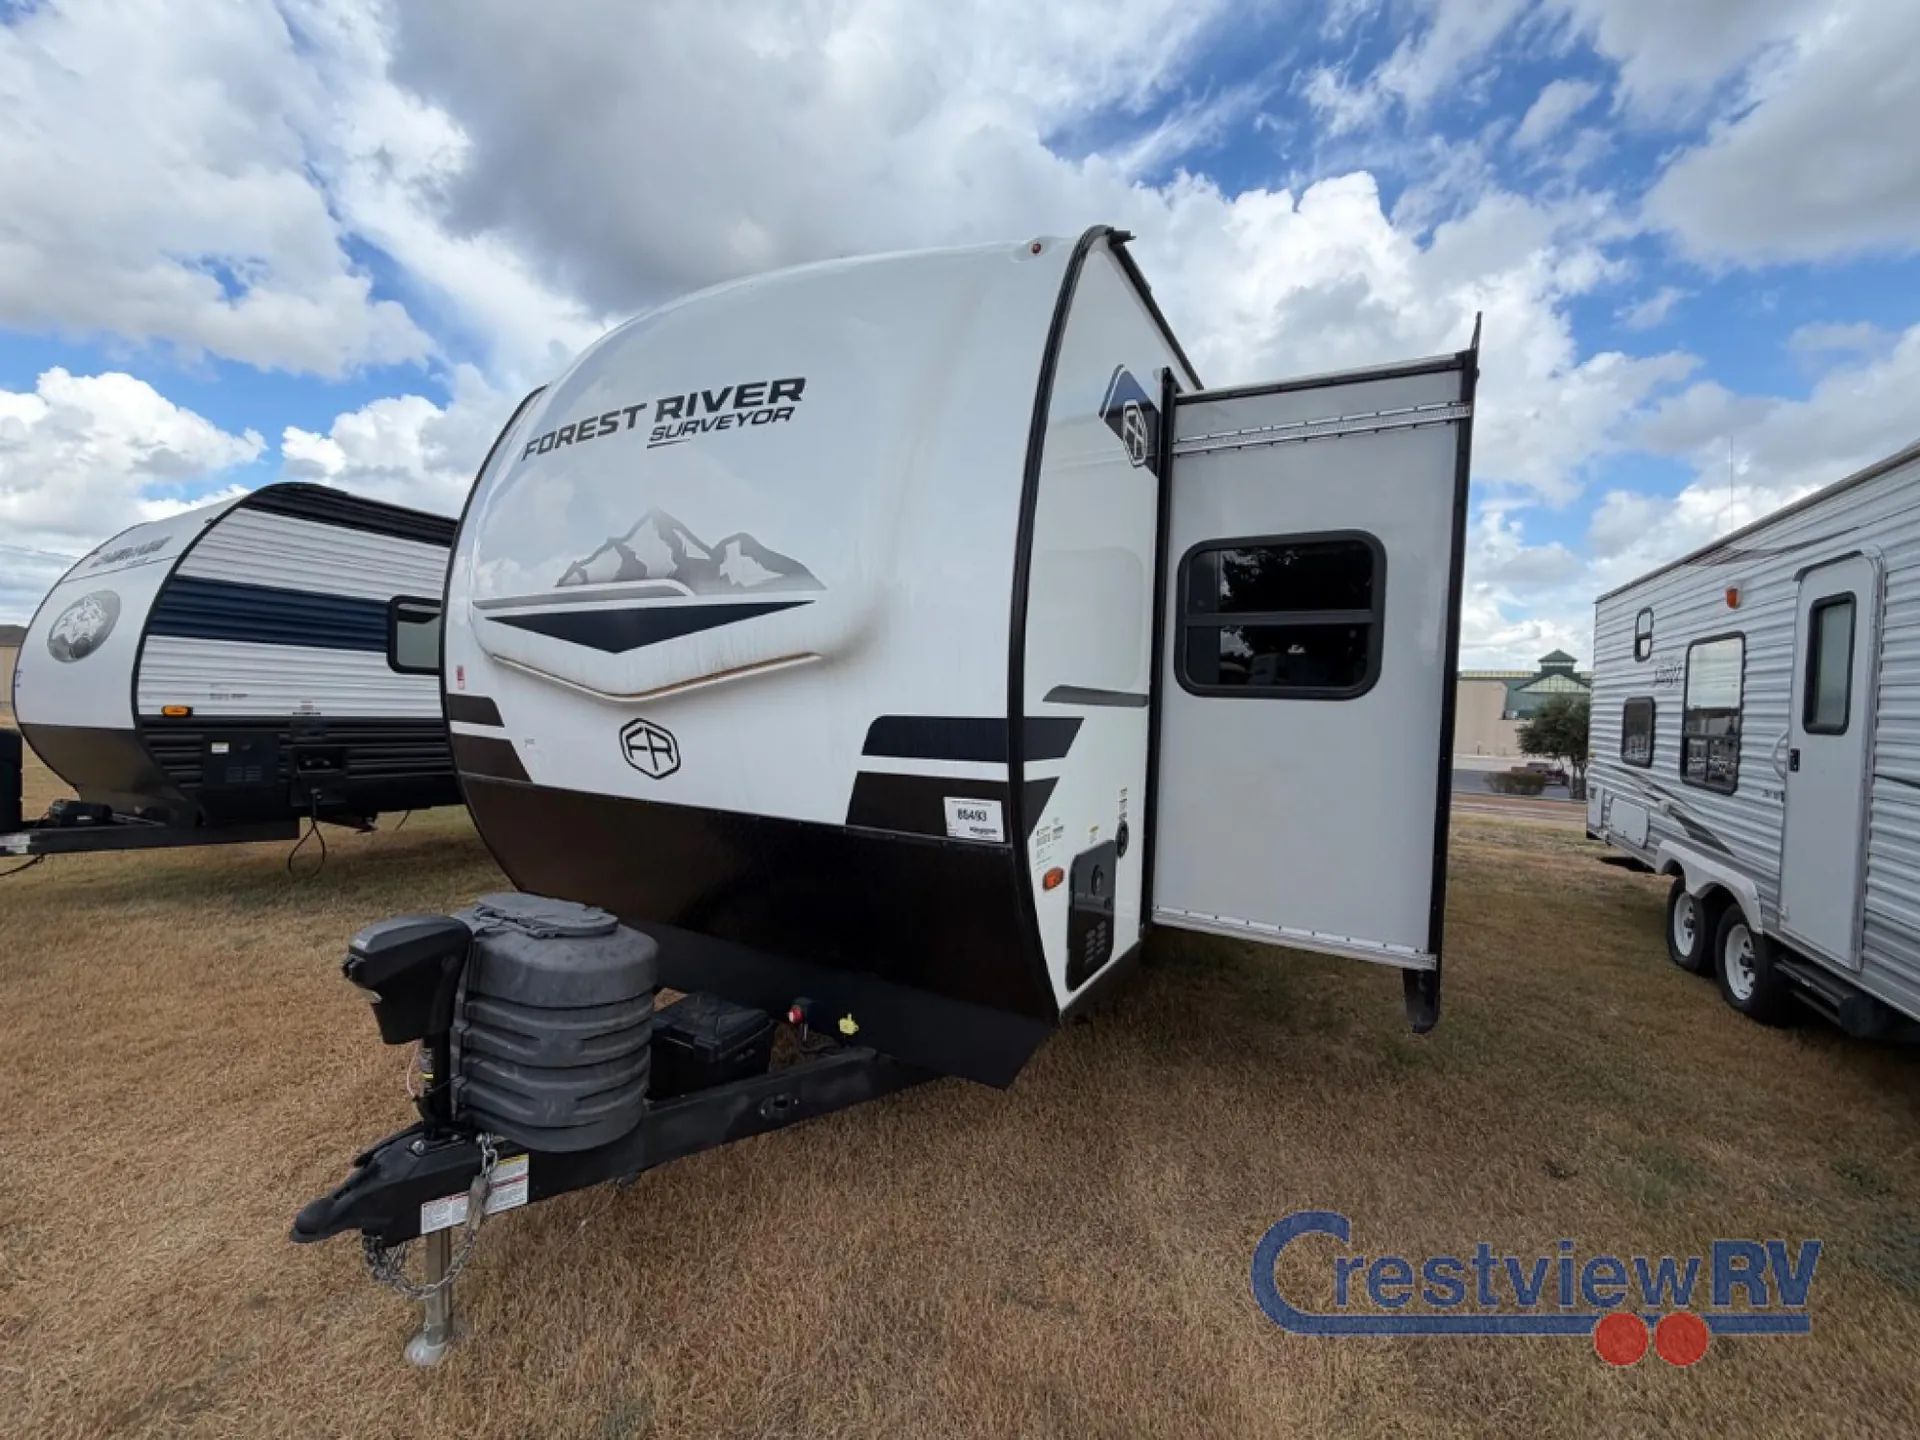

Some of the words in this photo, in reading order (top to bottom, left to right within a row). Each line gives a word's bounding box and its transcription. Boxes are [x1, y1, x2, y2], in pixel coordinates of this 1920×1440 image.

[521, 402, 648, 462] FOREST
[654, 376, 807, 423] RIVER
[649, 406, 796, 442] SURVEYOR
